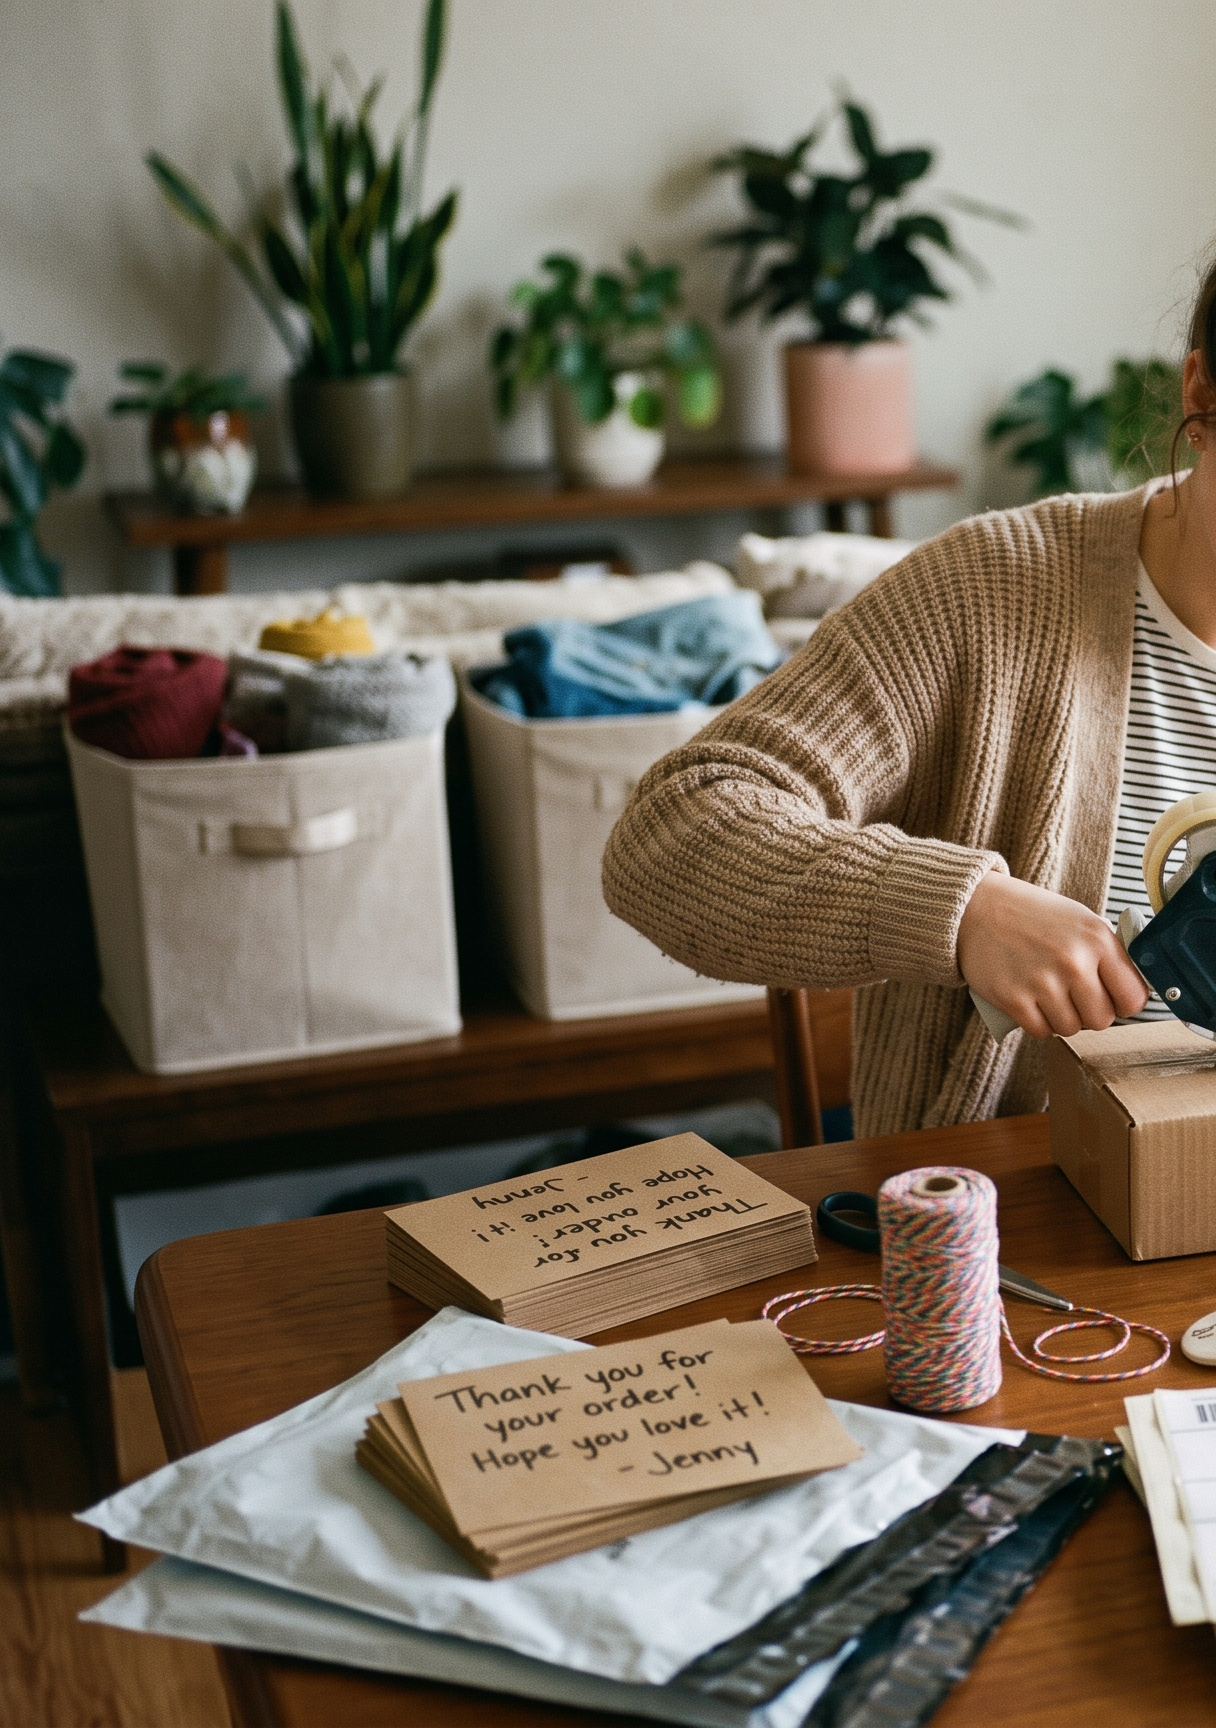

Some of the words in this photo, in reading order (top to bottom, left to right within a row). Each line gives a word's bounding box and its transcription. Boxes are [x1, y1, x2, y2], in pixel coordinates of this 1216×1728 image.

[641, 1164, 714, 1191] Hope
[471, 1178, 564, 1211] Jenny
[586, 1182, 634, 1206] you
[655, 1184, 723, 1211] your
[521, 1202, 580, 1224] love
[655, 1198, 768, 1231] Thank
[470, 1220, 516, 1244] it!
[591, 1225, 648, 1249] you
[532, 1247, 580, 1269] for
[434, 1374, 571, 1414] Thank
[585, 1361, 643, 1396] you
[658, 1349, 715, 1371] for
[484, 1404, 562, 1442] your
[584, 1374, 701, 1417] order!
[471, 1442, 559, 1474] Hope
[573, 1426, 629, 1460] you
[642, 1410, 709, 1437] love
[718, 1390, 771, 1421] it!
[648, 1438, 761, 1478] Jenny
